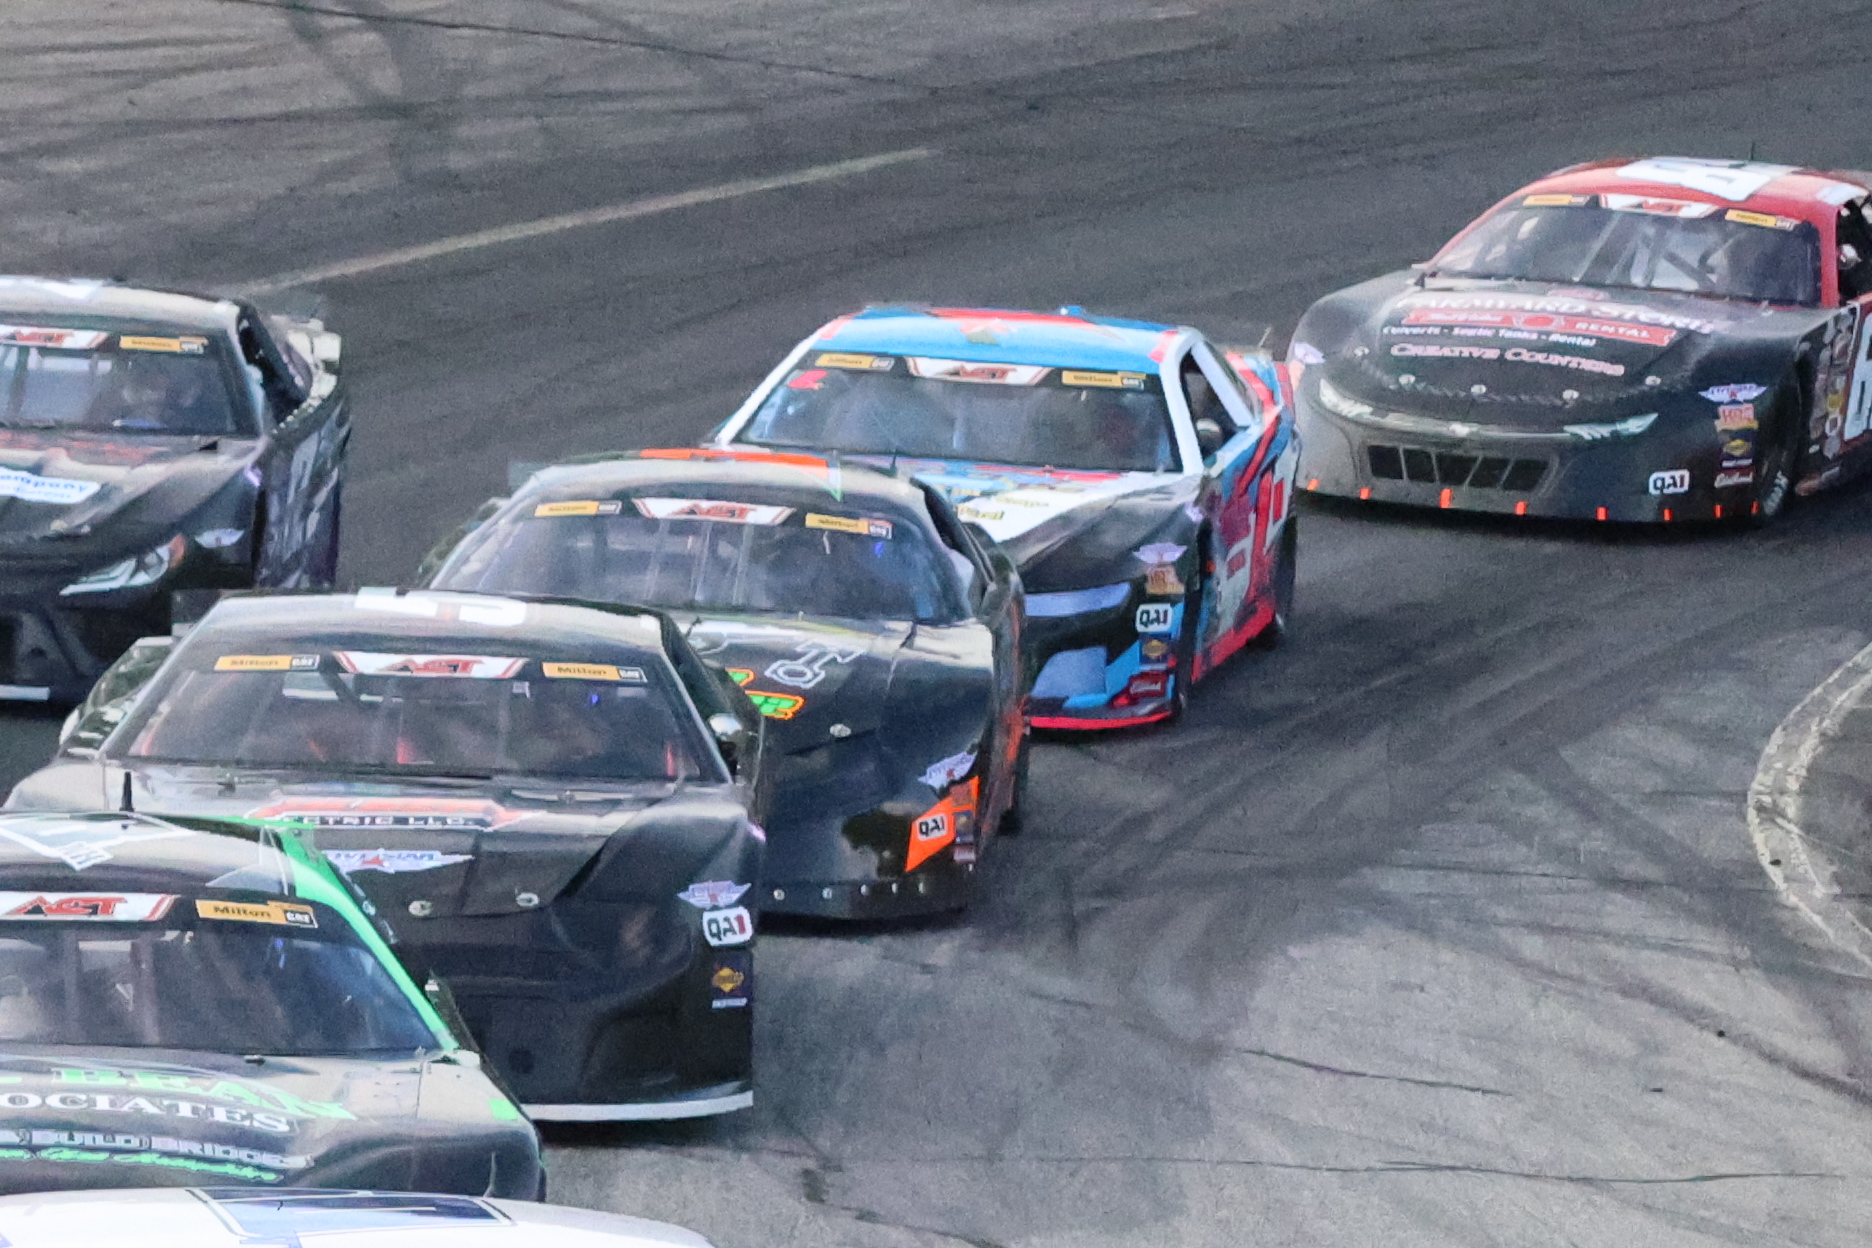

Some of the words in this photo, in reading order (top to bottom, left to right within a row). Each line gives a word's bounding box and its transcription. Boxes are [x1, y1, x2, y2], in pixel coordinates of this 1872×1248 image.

[1653, 473, 1686, 491] QA1
[918, 815, 946, 838] QA1
[1, 895, 129, 917] ACT
[212, 904, 272, 920] Milton
[287, 910, 312, 923] CAT
[706, 913, 747, 942] QA1
[51, 1067, 357, 1121] BEAN
